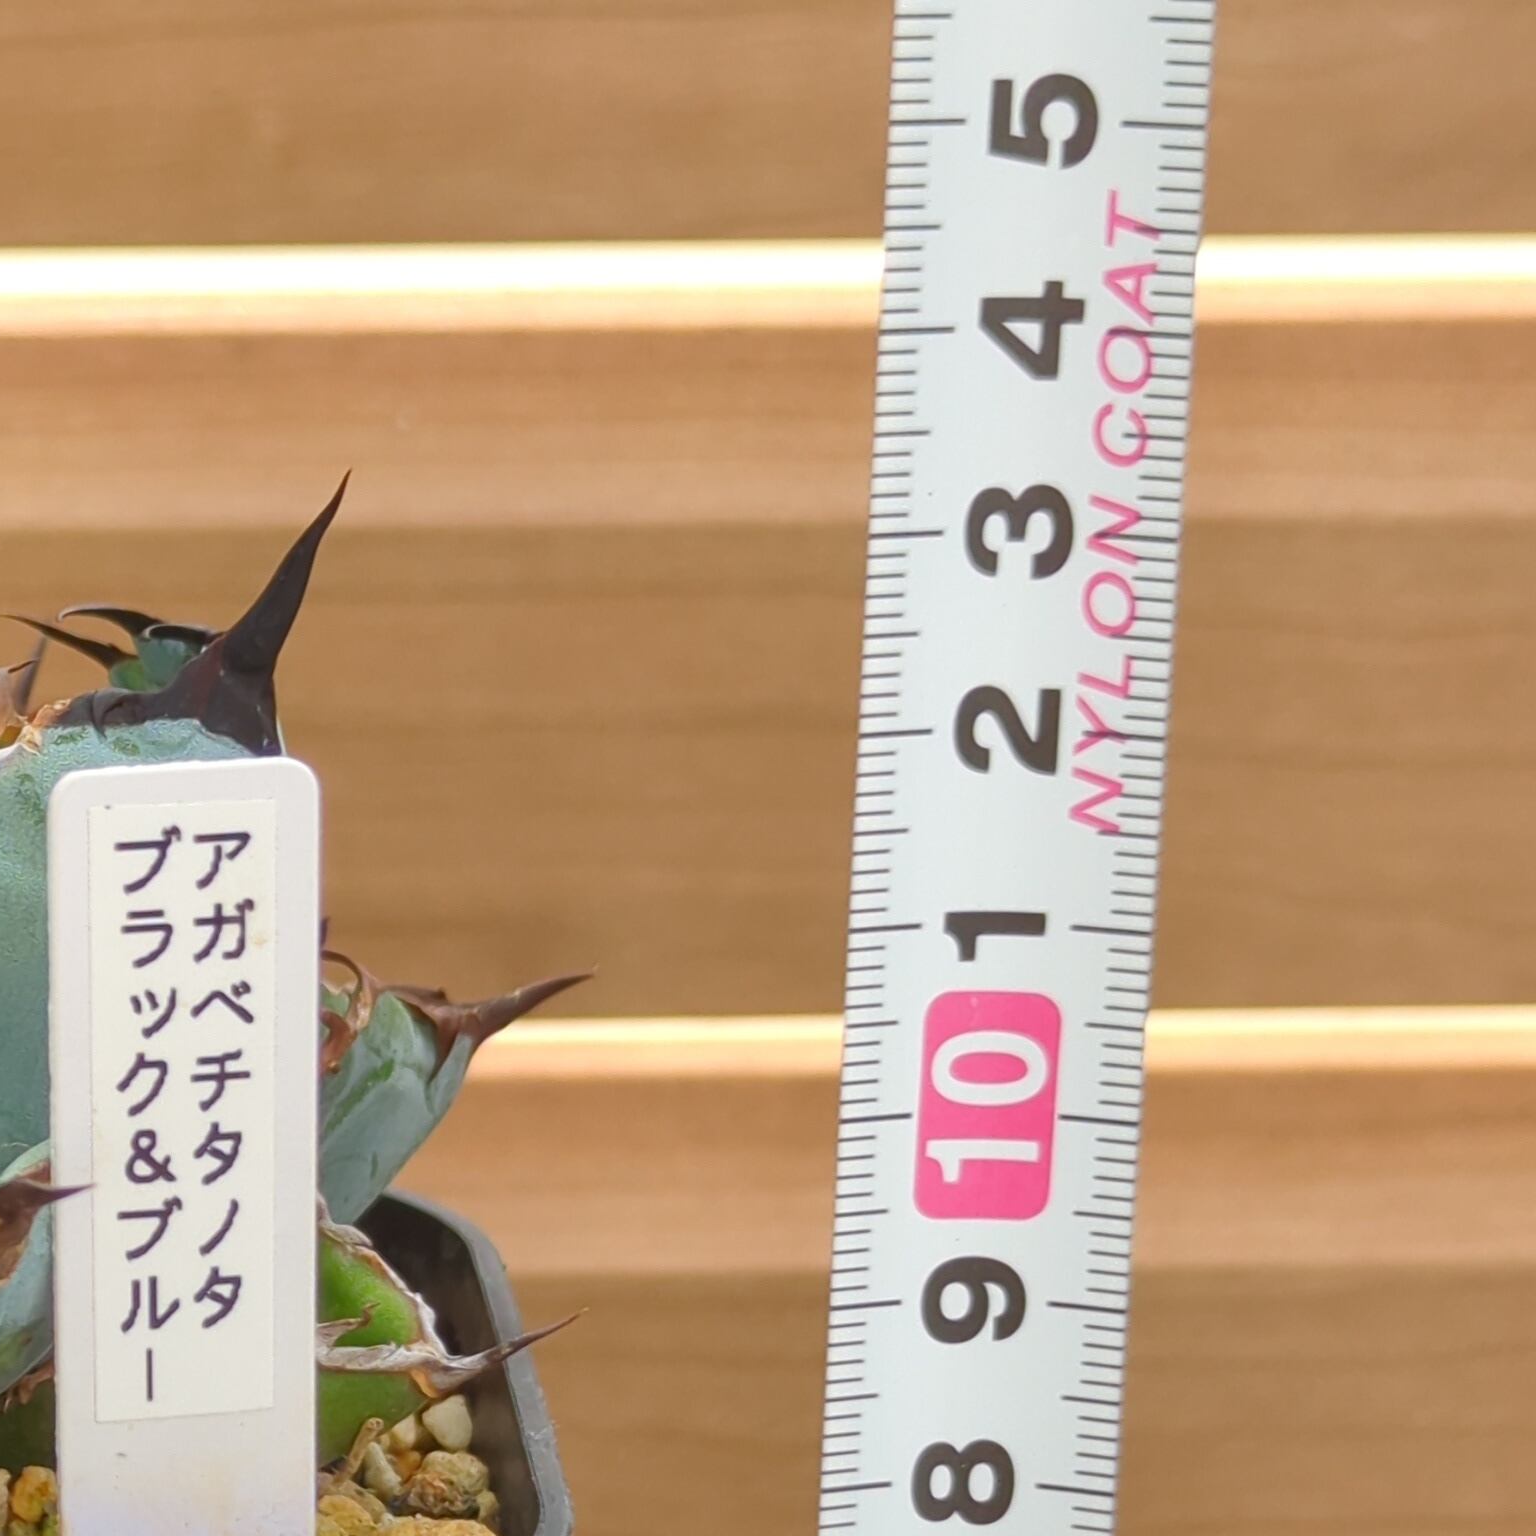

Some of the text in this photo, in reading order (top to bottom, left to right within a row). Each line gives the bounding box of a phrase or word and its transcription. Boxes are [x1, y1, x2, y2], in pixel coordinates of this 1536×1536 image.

[987, 72, 1100, 170] 5
[978, 280, 1086, 379] 4
[963, 483, 1074, 580] 3
[1068, 188, 1162, 832] NYLON COAT
[953, 684, 1062, 776] 2
[942, 910, 1048, 963] 1
[113, 826, 183, 1403] ブラック&ブルー
[189, 830, 256, 1330] アガベチタノタ
[925, 1029, 1049, 1185] 10
[920, 1255, 1027, 1345] 9
[911, 1439, 1015, 1526] 8
